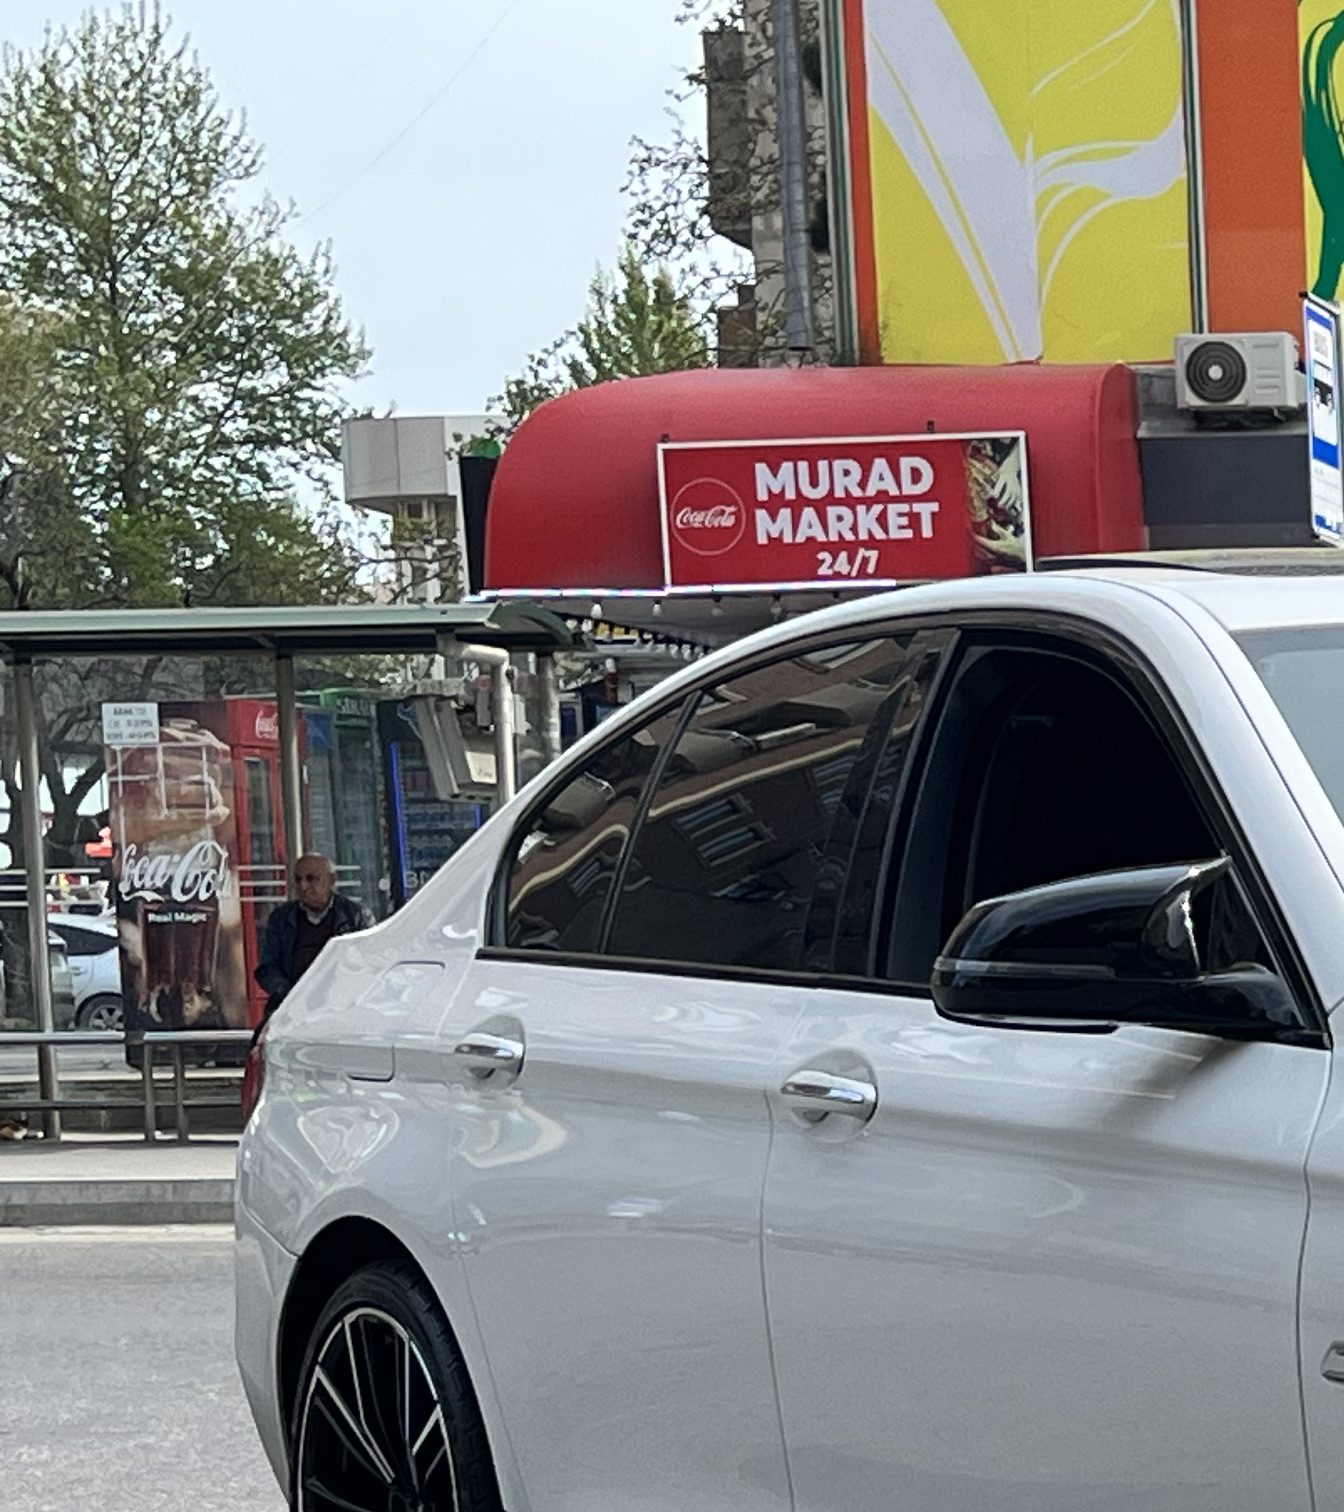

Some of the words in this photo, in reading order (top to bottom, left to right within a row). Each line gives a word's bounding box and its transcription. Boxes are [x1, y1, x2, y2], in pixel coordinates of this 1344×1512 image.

[754, 455, 935, 501] MURAD
[755, 502, 940, 544] MARKET
[816, 547, 880, 577] 24/7
